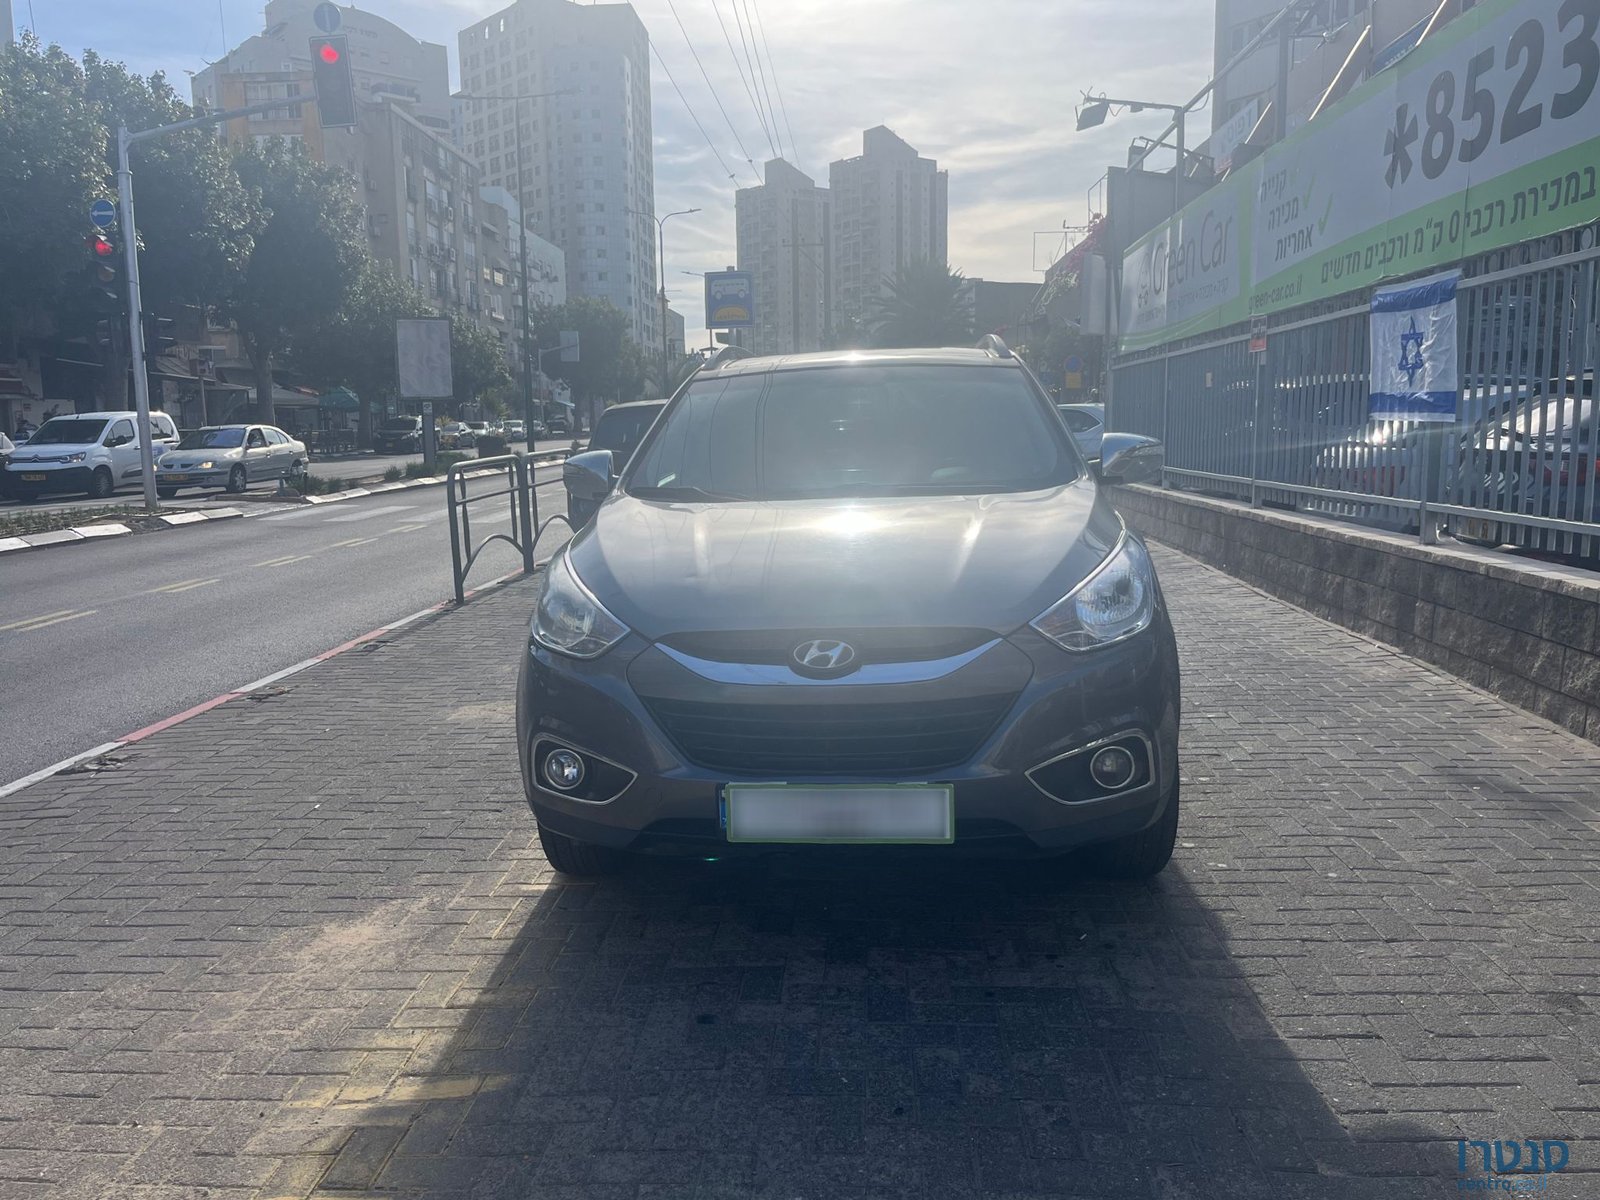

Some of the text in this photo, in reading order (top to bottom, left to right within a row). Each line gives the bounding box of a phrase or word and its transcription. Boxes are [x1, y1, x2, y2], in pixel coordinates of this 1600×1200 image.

[1268, 196, 1299, 231] מכירה
[1510, 166, 1597, 224] במכירת
[1153, 237, 1196, 295] Green
[1200, 209, 1233, 272] Car
[1275, 224, 1314, 262] אחריות
[1364, 232, 1410, 270] ורכבים
[1321, 250, 1361, 284] חדשים
